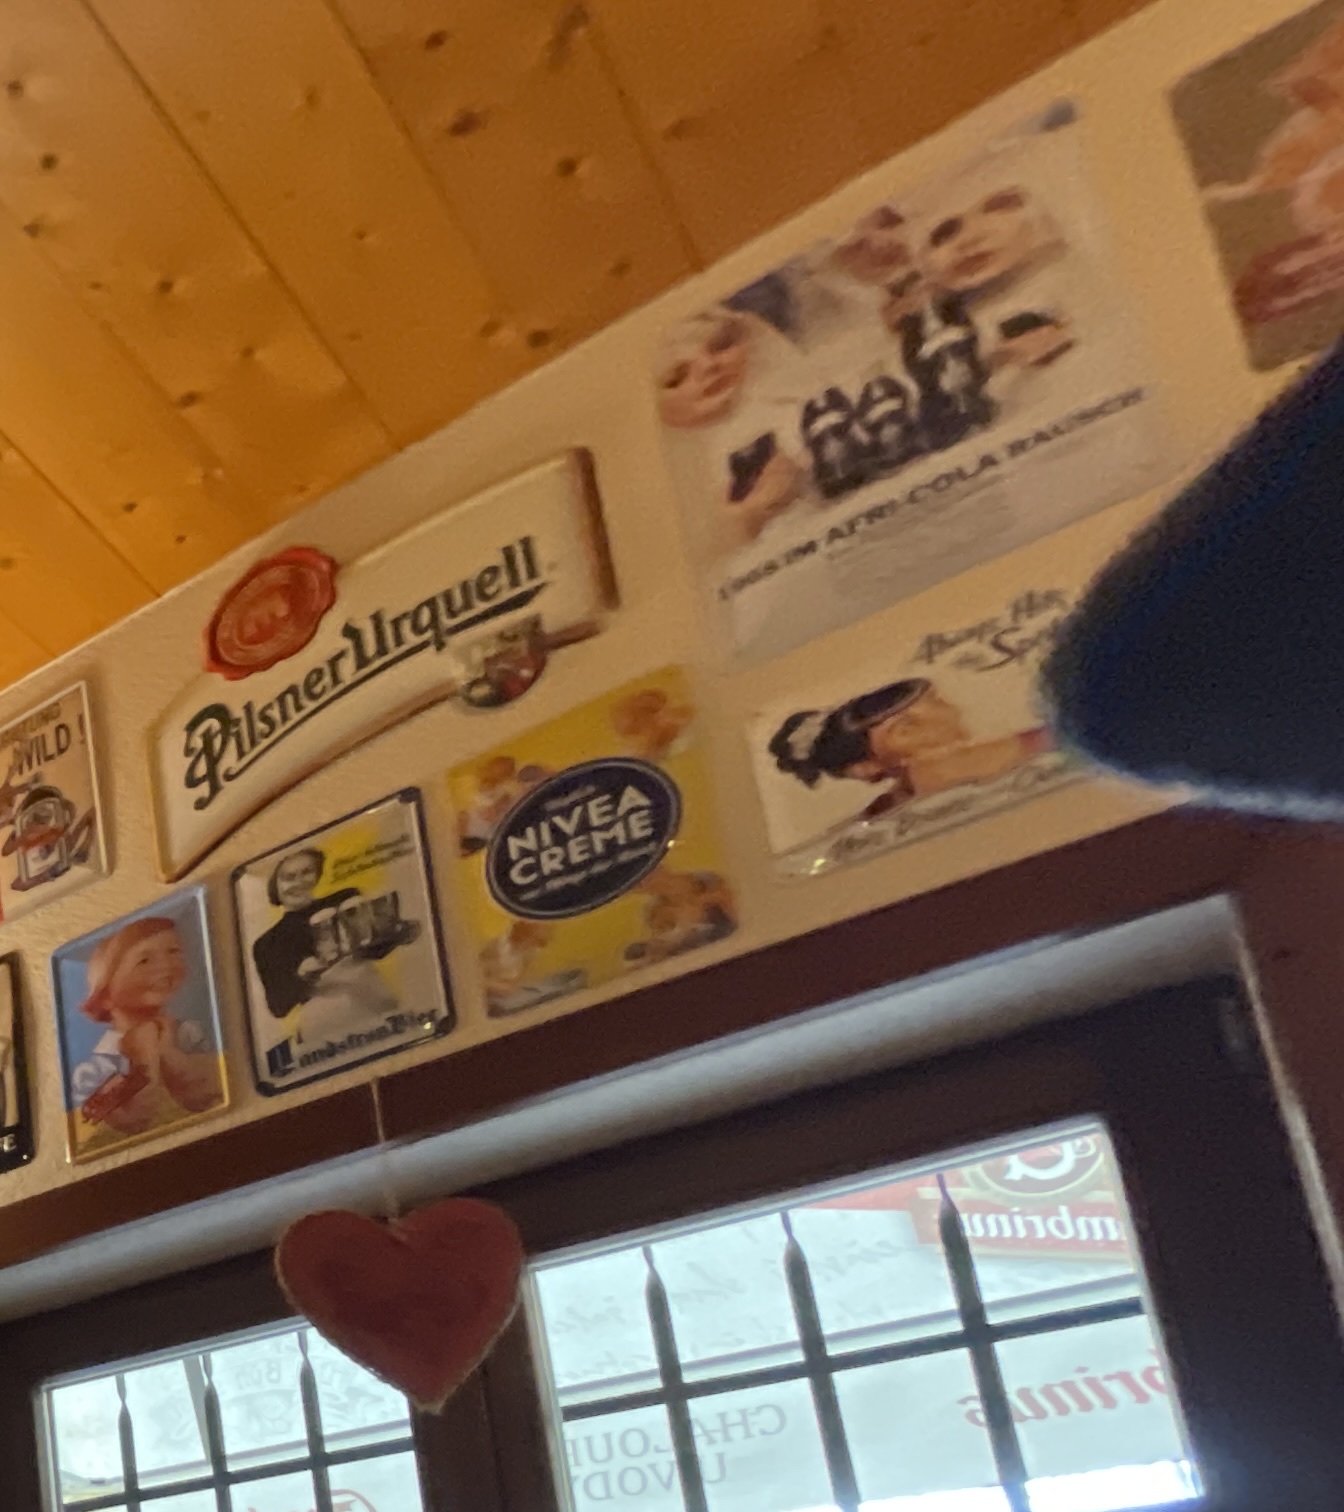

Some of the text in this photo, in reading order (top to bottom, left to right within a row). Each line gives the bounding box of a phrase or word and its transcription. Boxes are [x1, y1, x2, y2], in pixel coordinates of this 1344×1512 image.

[183, 535, 540, 811] Pilsner Urquell
[507, 784, 653, 861] NIVEA
[509, 808, 654, 885] CREME
